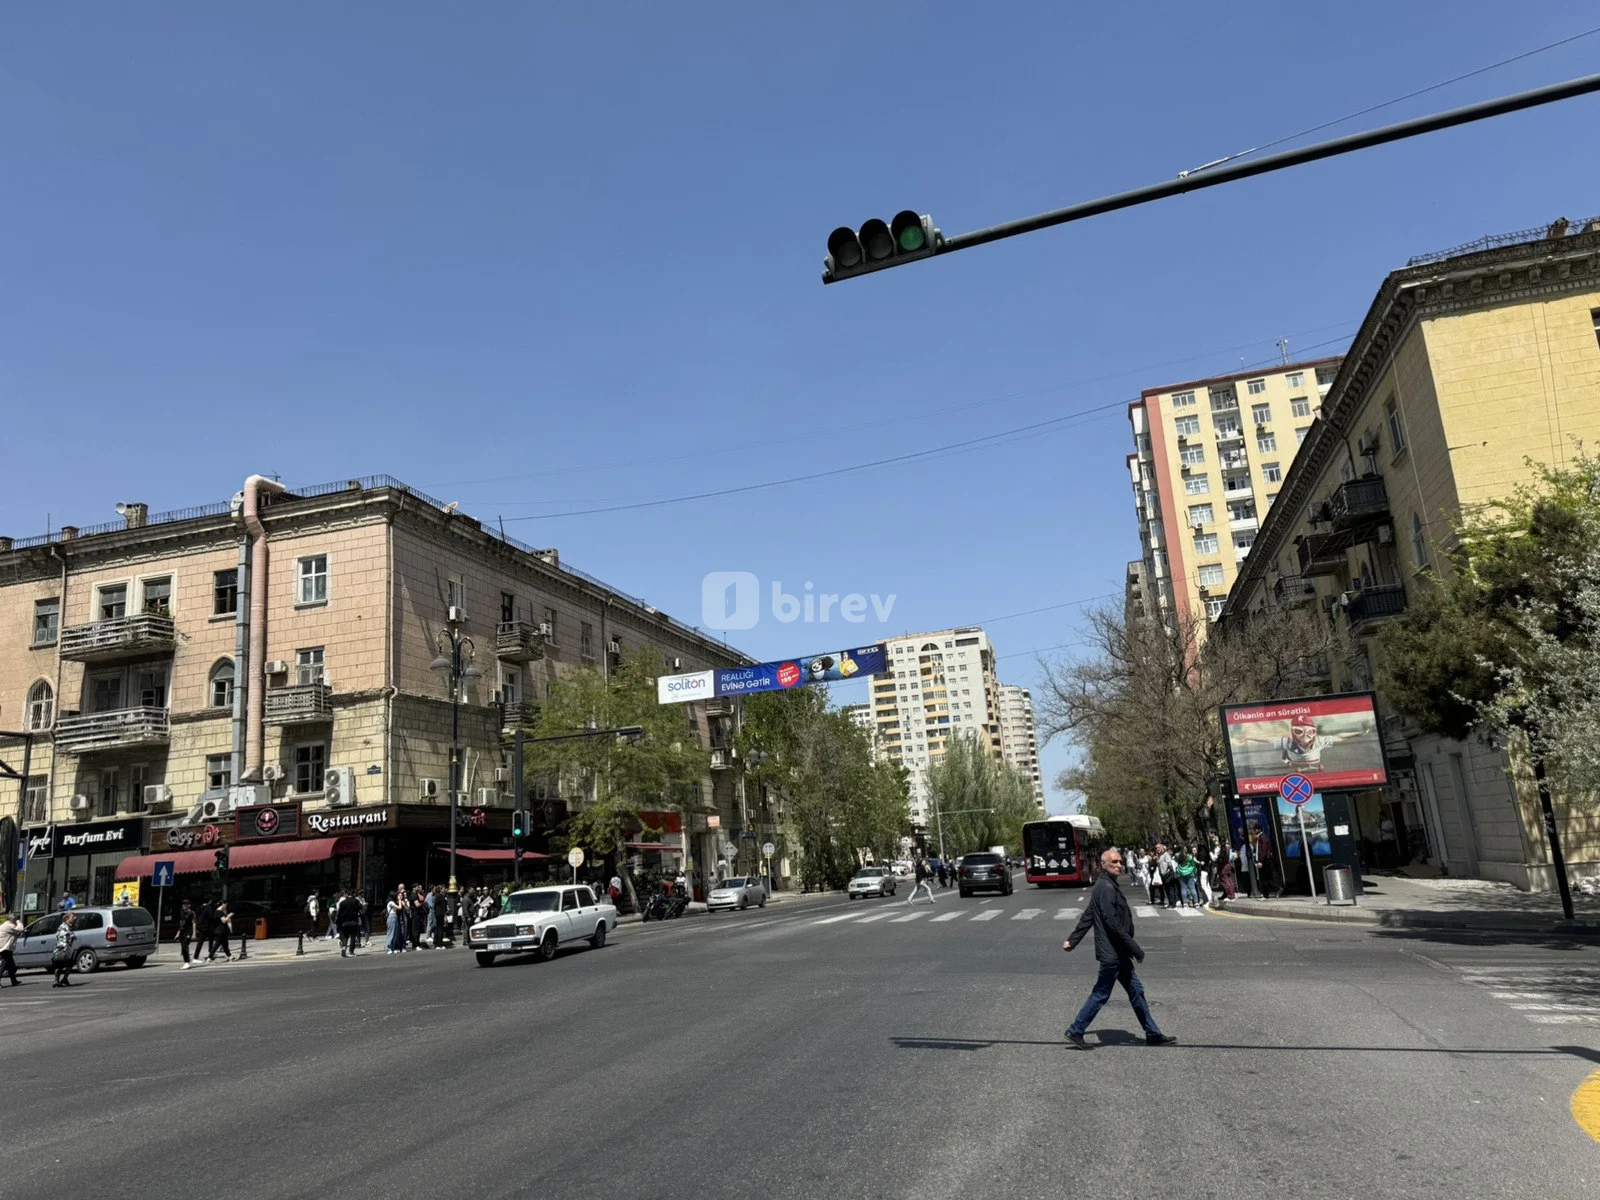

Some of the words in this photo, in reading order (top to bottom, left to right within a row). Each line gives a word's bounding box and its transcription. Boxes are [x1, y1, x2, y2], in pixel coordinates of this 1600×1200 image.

[668, 678, 705, 692] soliton
[746, 677, 770, 688] GƏTİR
[1233, 711, 1264, 721] Ölkənin
[1278, 707, 1310, 717] sürətlisi
[1252, 782, 1279, 790] bakcell
[308, 810, 388, 832] Restaurant
[63, 832, 104, 846] Parfum
[105, 828, 124, 841] Evi
